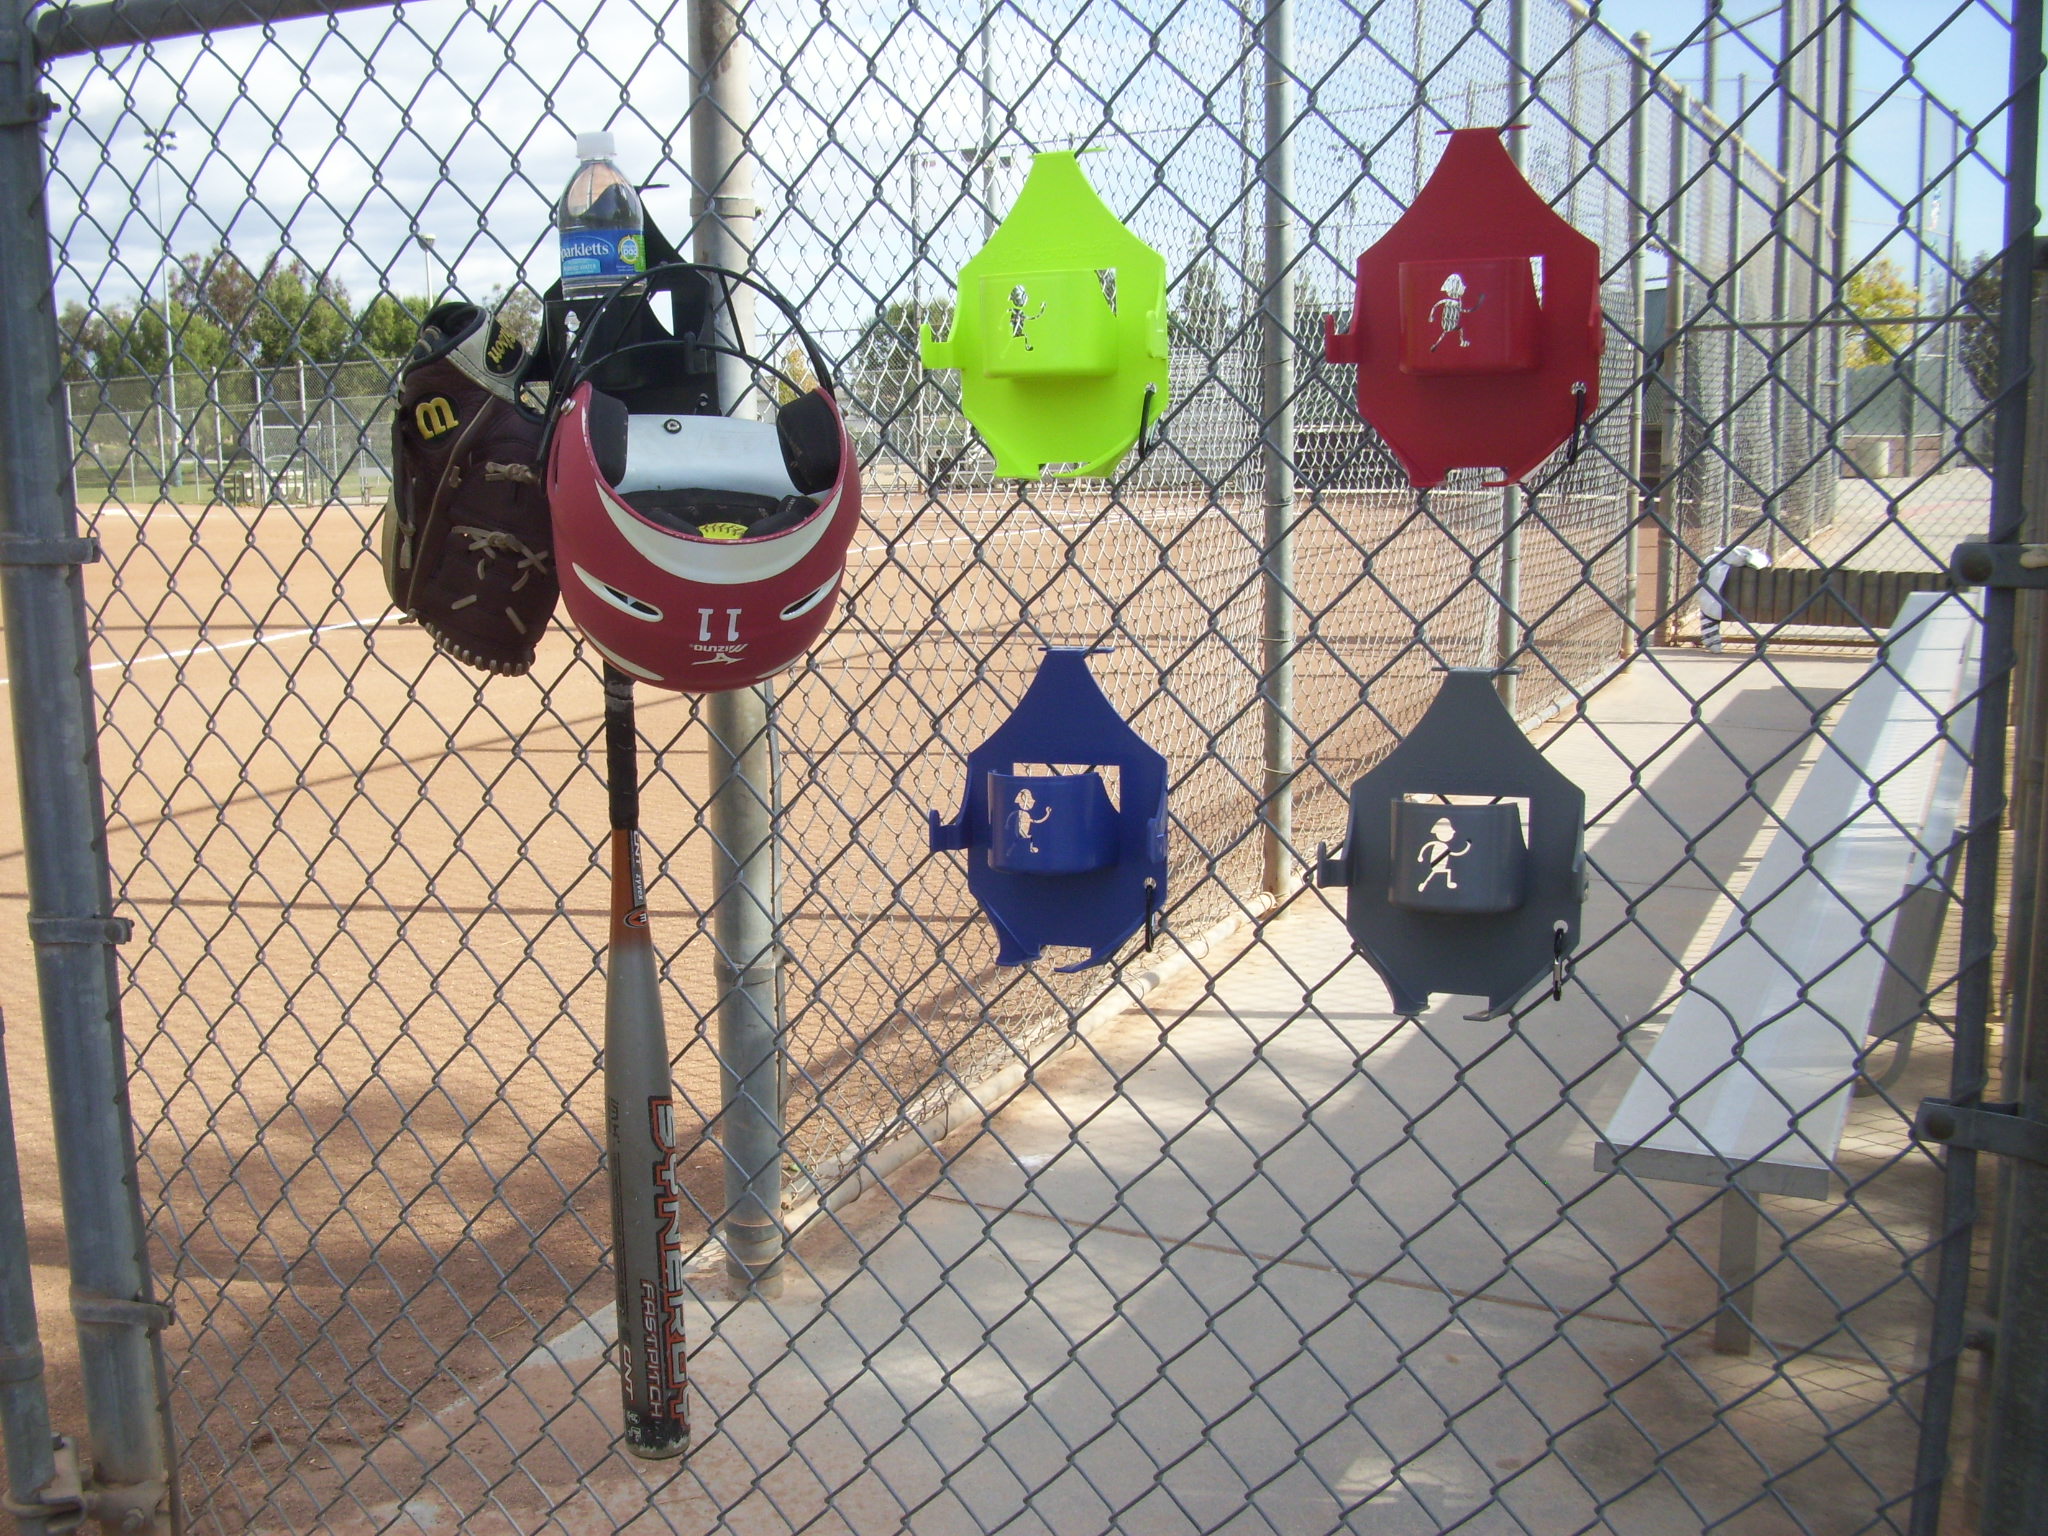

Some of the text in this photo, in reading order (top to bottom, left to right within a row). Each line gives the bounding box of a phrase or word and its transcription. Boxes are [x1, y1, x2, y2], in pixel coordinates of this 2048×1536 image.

[561, 243, 609, 261] parkletts
[697, 608, 742, 642] 11
[641, 1280, 663, 1418] FASTPITCH
[623, 1344, 634, 1401] CNT
